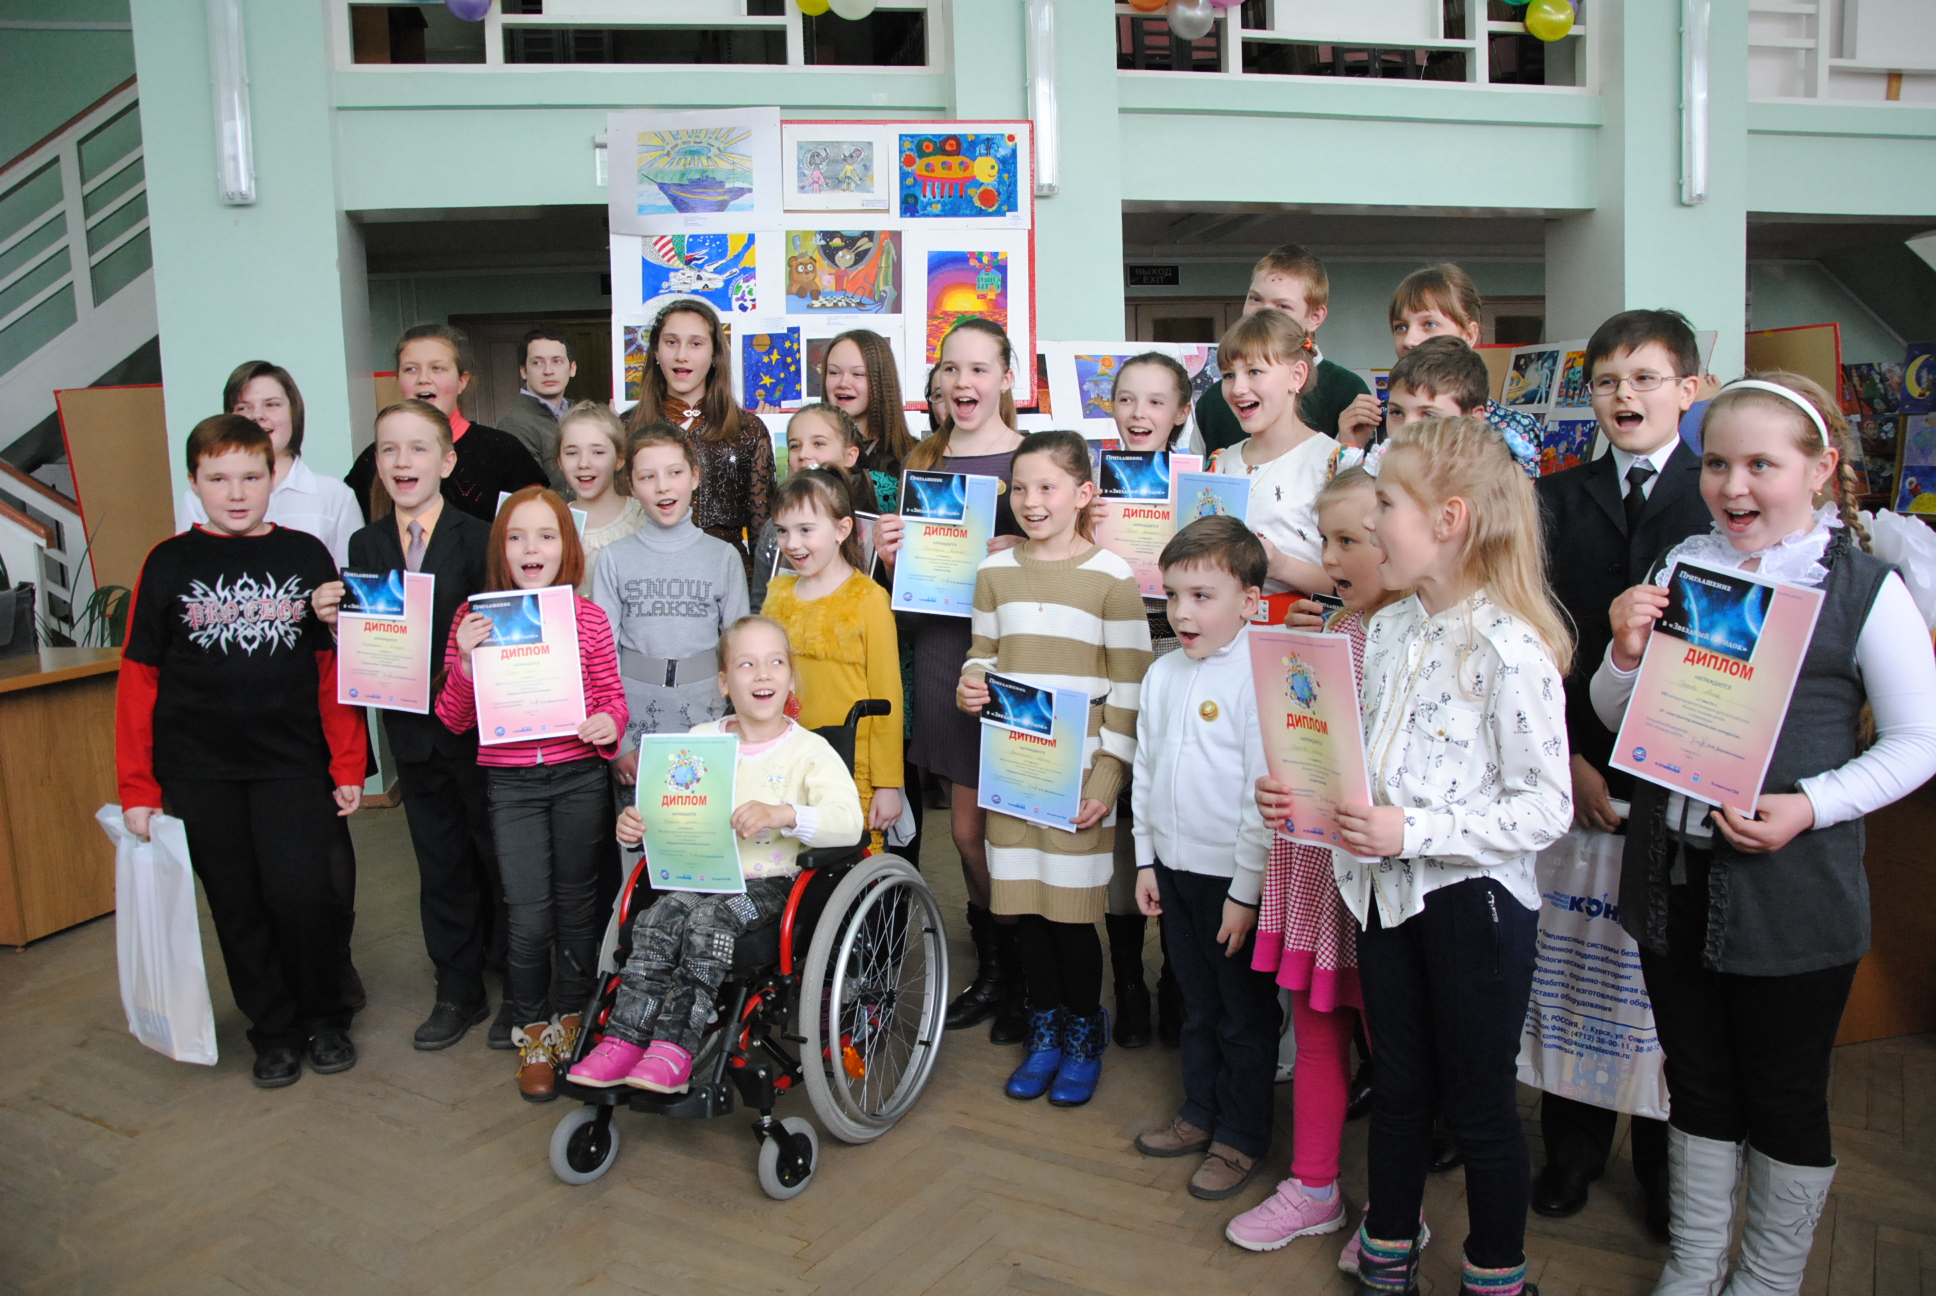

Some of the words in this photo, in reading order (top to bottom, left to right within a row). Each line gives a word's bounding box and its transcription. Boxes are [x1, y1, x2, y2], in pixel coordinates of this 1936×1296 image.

[1135, 268, 1172, 277] ВЫХОД
[1143, 276, 1165, 284] EXIT
[1122, 508, 1170, 520] ДИПЛОМ
[923, 526, 968, 538] ДИПЛОМ
[625, 578, 712, 601] SNOW
[185, 600, 240, 631] PRO
[243, 599, 306, 622] EDGE
[364, 621, 408, 634] ДИПЛОМ
[501, 645, 550, 661] ДИПЛОМ
[1683, 647, 1755, 681] ДИПЛОМ
[1287, 713, 1329, 736] ДИПЛОМ
[1009, 730, 1057, 748] ДИПЛОМ
[661, 795, 708, 808] ДИПЛОМ
[1586, 942, 1619, 954] системы
[1620, 948, 1640, 958] безо
[1587, 966, 1632, 980] мониторинг
[1569, 972, 1638, 993] охранно-пожарная
[1560, 993, 1612, 1012] оборудования
[1575, 987, 1628, 1004] изготовление
[1551, 1014, 1580, 1030] РОССИЯ,
[1590, 1026, 1613, 1038] Курск,
[1571, 1031, 1594, 1043] (4712)
[1542, 1033, 1630, 1059] convers@kursktelecom.ru
